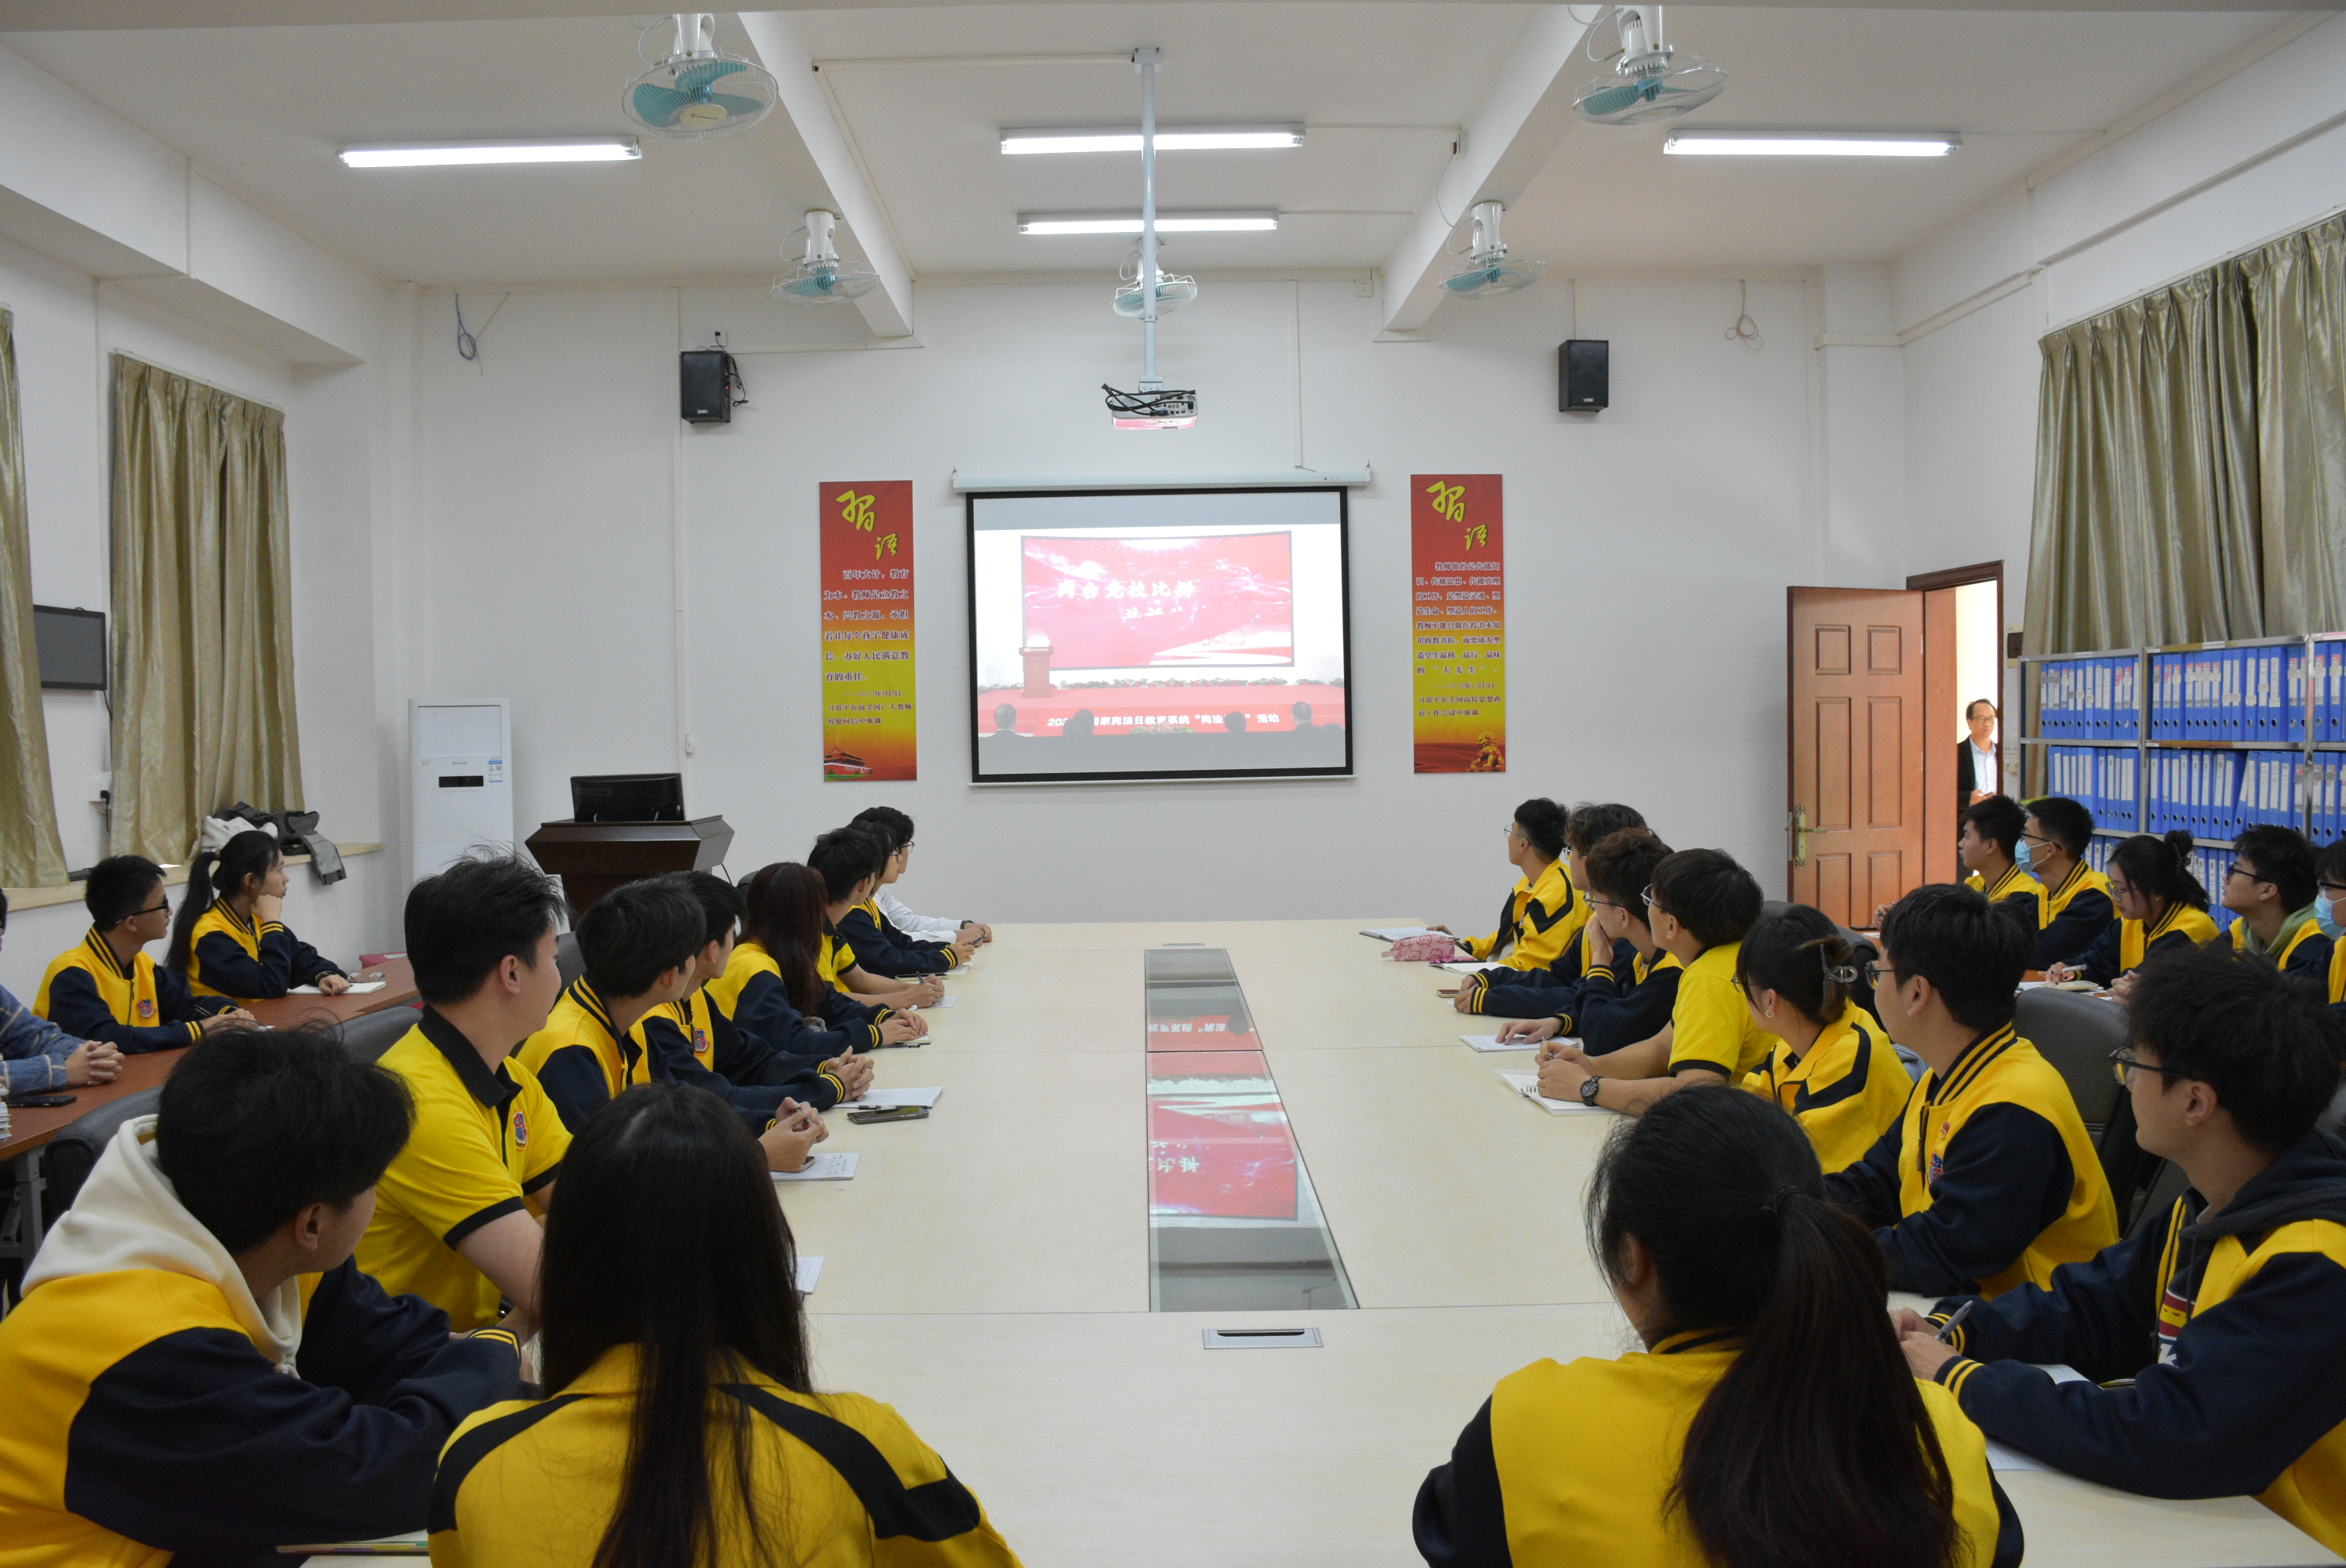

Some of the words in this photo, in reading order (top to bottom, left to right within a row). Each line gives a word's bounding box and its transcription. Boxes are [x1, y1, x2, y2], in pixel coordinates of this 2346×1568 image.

[1436, 562, 1501, 571] 教师做的是传播知
[843, 569, 909, 579] 百年大计，教育
[824, 590, 909, 601] 为本。教师是立教之
[824, 610, 909, 620] 本、兴教之源，承担
[825, 630, 909, 641] 着让每个孩子健康成
[826, 652, 910, 661] 长、办好人民满意教
[826, 673, 868, 682] 育的重任。
